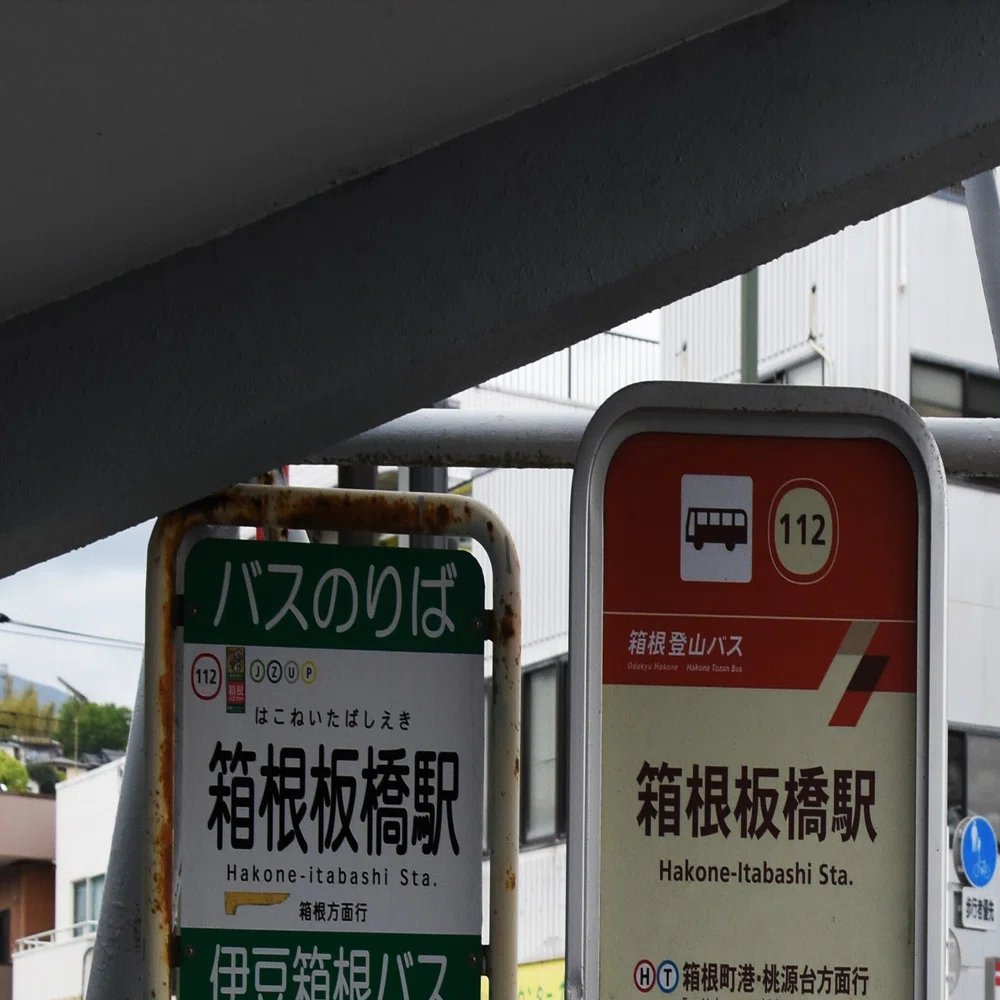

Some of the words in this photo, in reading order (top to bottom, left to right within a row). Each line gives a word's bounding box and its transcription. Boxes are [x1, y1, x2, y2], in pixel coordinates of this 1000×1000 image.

[780, 514, 826, 546] 112
[213, 560, 457, 638] バスのりば
[628, 630, 743, 656] 箱根登山バス
[196, 668, 217, 685] 112
[628, 662, 652, 672] Odakyu
[654, 662, 678, 671] Hakone
[686, 664, 710, 672] Hakone
[712, 664, 730, 672] Tozan
[731, 664, 742, 672] Bus
[255, 708, 411, 730] はこねいたばしえき
[208, 741, 460, 856] 箱根板橋駅
[636, 760, 878, 843] 箱根板橋駅
[227, 864, 388, 886] Hakone-itabashi
[400, 868, 437, 887] Sta.
[659, 860, 812, 884] Hakone-Itabashi
[819, 864, 853, 886] Sta.
[300, 901, 368, 922] 箱根方面行
[640, 966, 649, 986] H
[664, 968, 672, 987] T
[682, 962, 869, 996] 箱根町港・桃源台方面行
